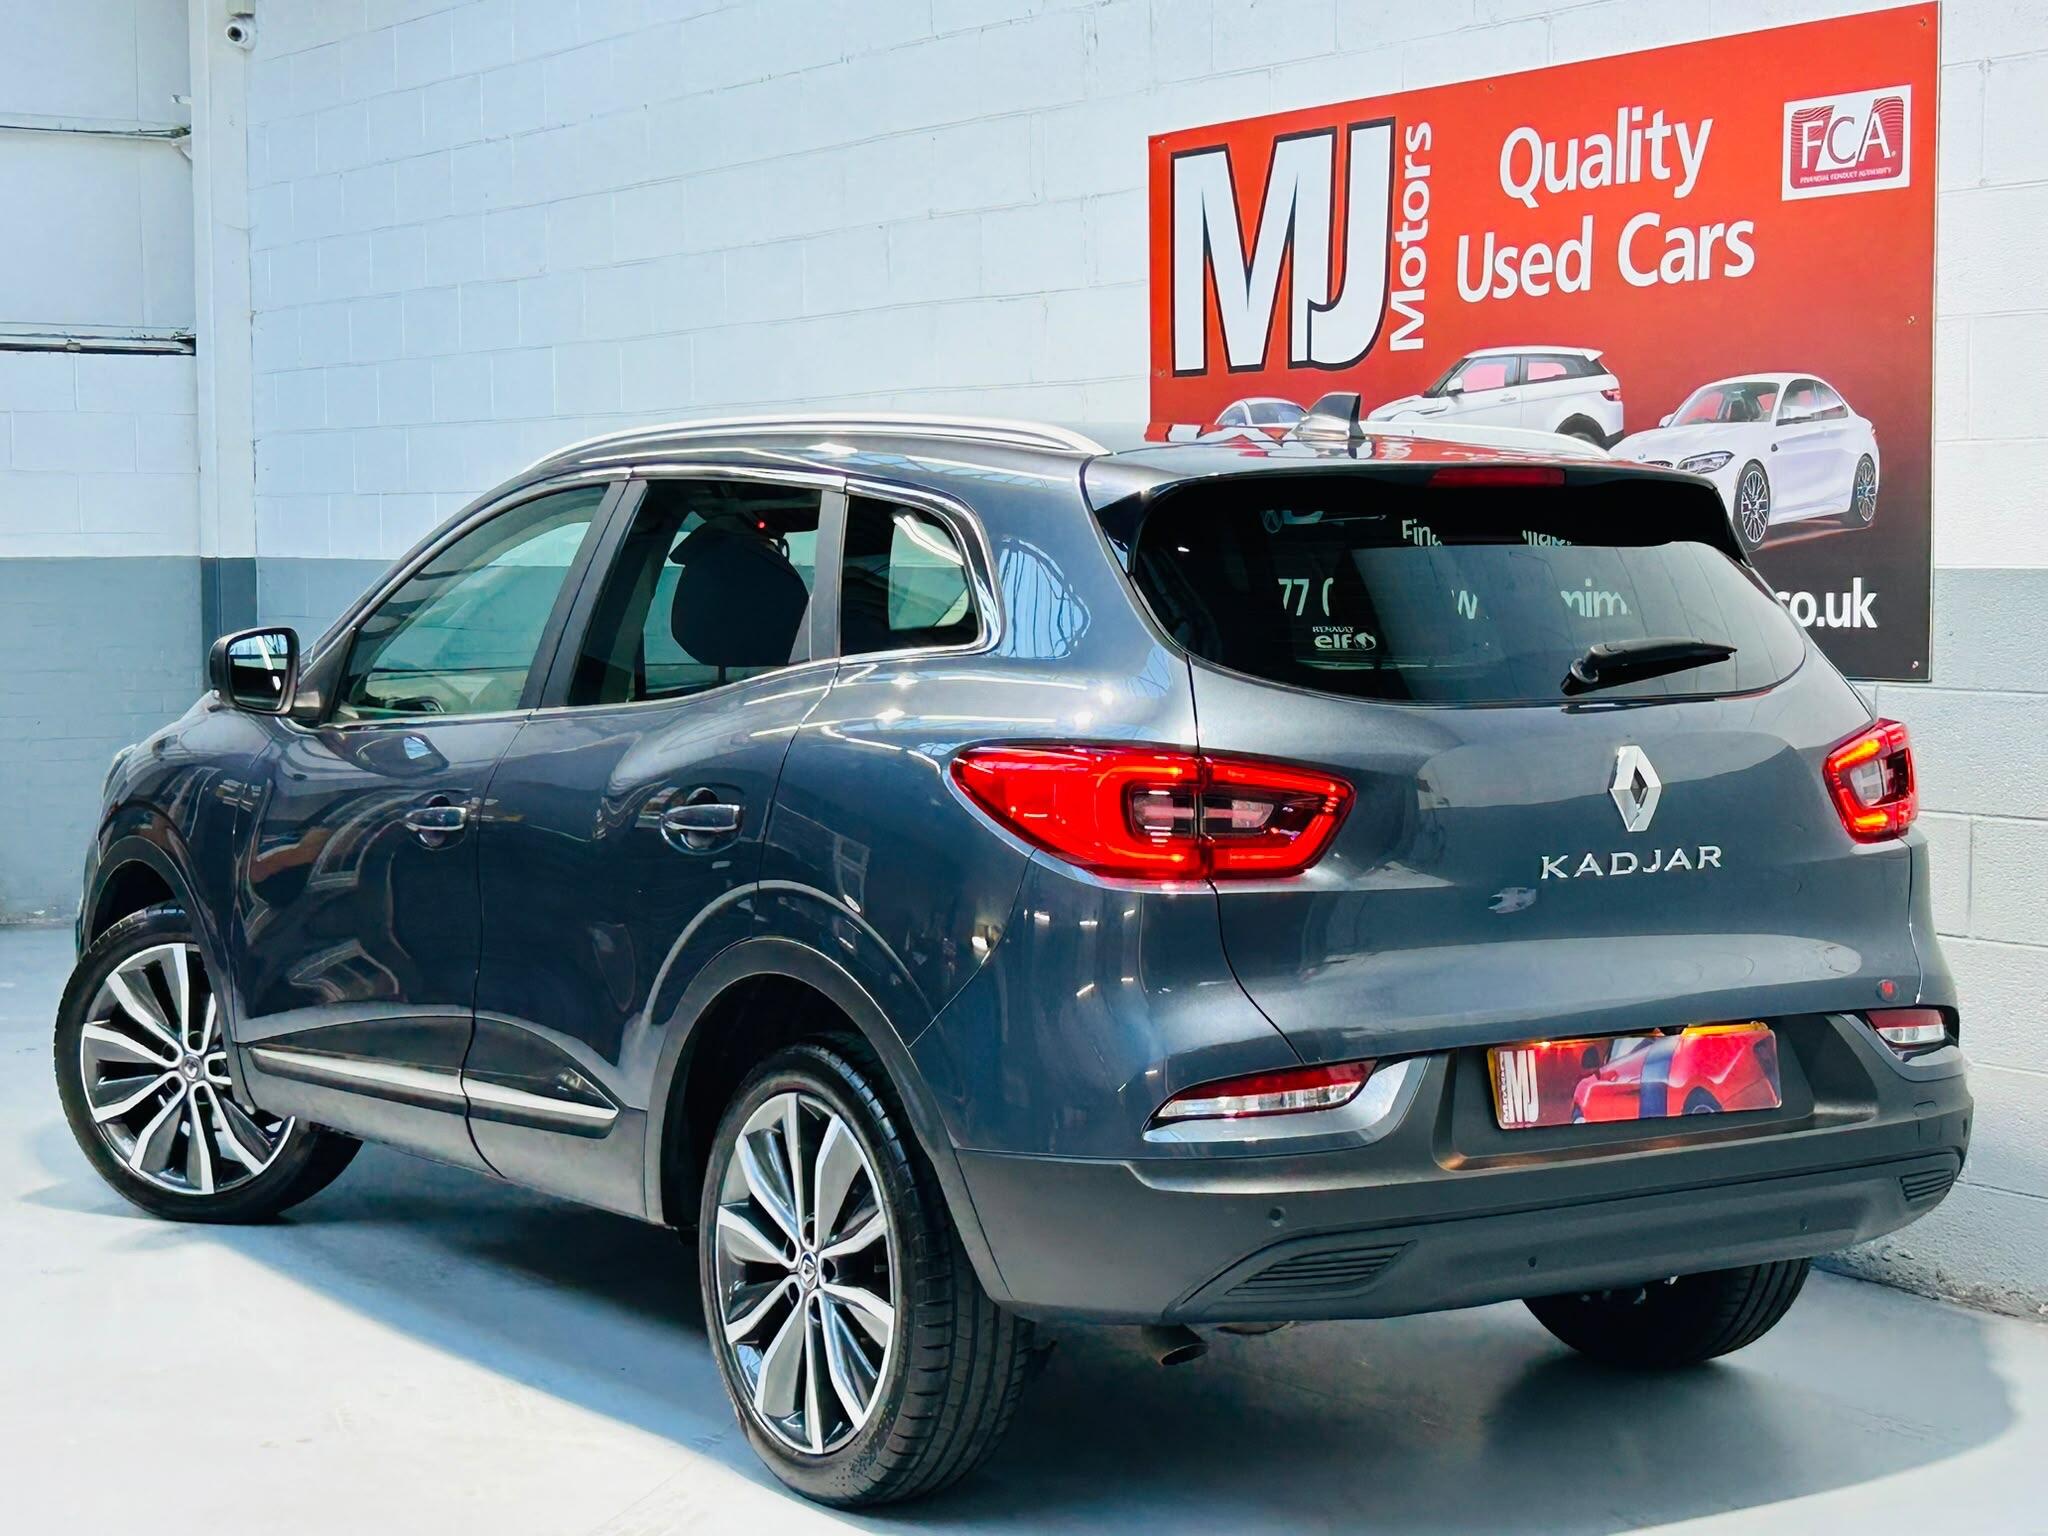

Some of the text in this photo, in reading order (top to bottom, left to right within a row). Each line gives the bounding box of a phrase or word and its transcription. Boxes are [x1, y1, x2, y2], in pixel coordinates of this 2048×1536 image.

[1499, 106, 1713, 208] Quality
[1801, 112, 1897, 169] FCA
[1171, 117, 1396, 377] MJ
[1390, 122, 1432, 351] Motors
[1457, 212, 1755, 303] Used Cars
[1314, 633, 1352, 649] elf
[1540, 846, 1722, 880] KADJAR
[1503, 1049, 1540, 1123] MJ
